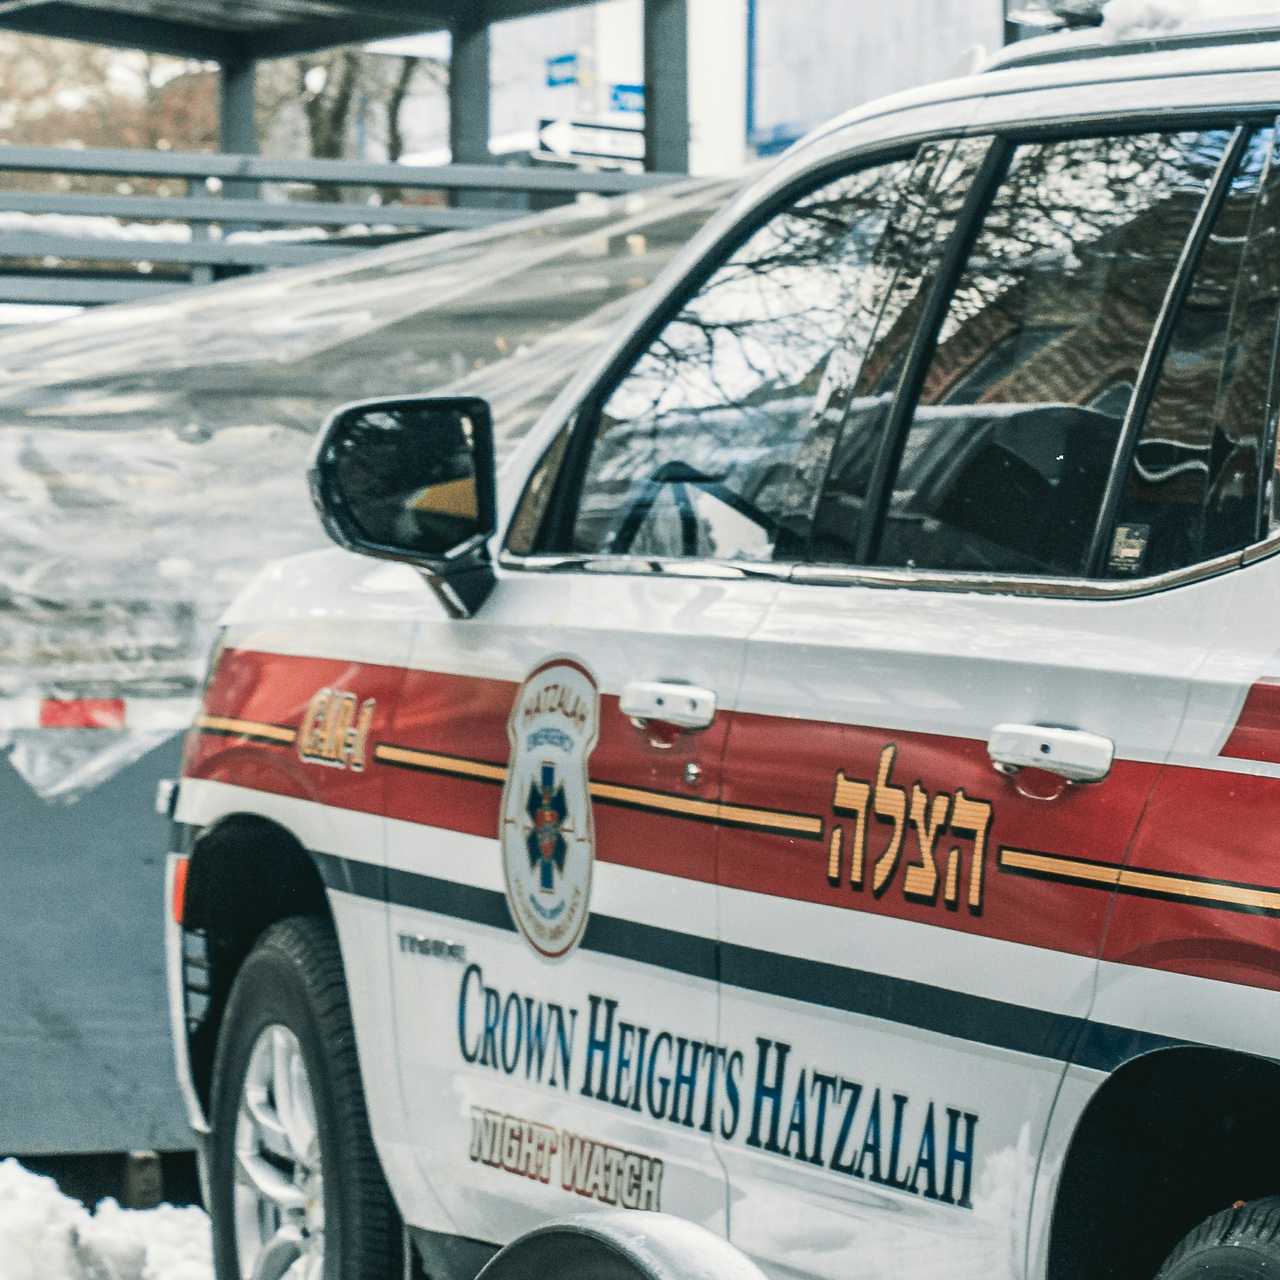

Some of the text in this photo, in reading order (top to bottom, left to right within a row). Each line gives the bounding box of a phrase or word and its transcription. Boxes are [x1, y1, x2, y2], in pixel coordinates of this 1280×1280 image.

[827, 742, 994, 917] הצלה
[469, 1104, 664, 1212] NIGHT WATCH
